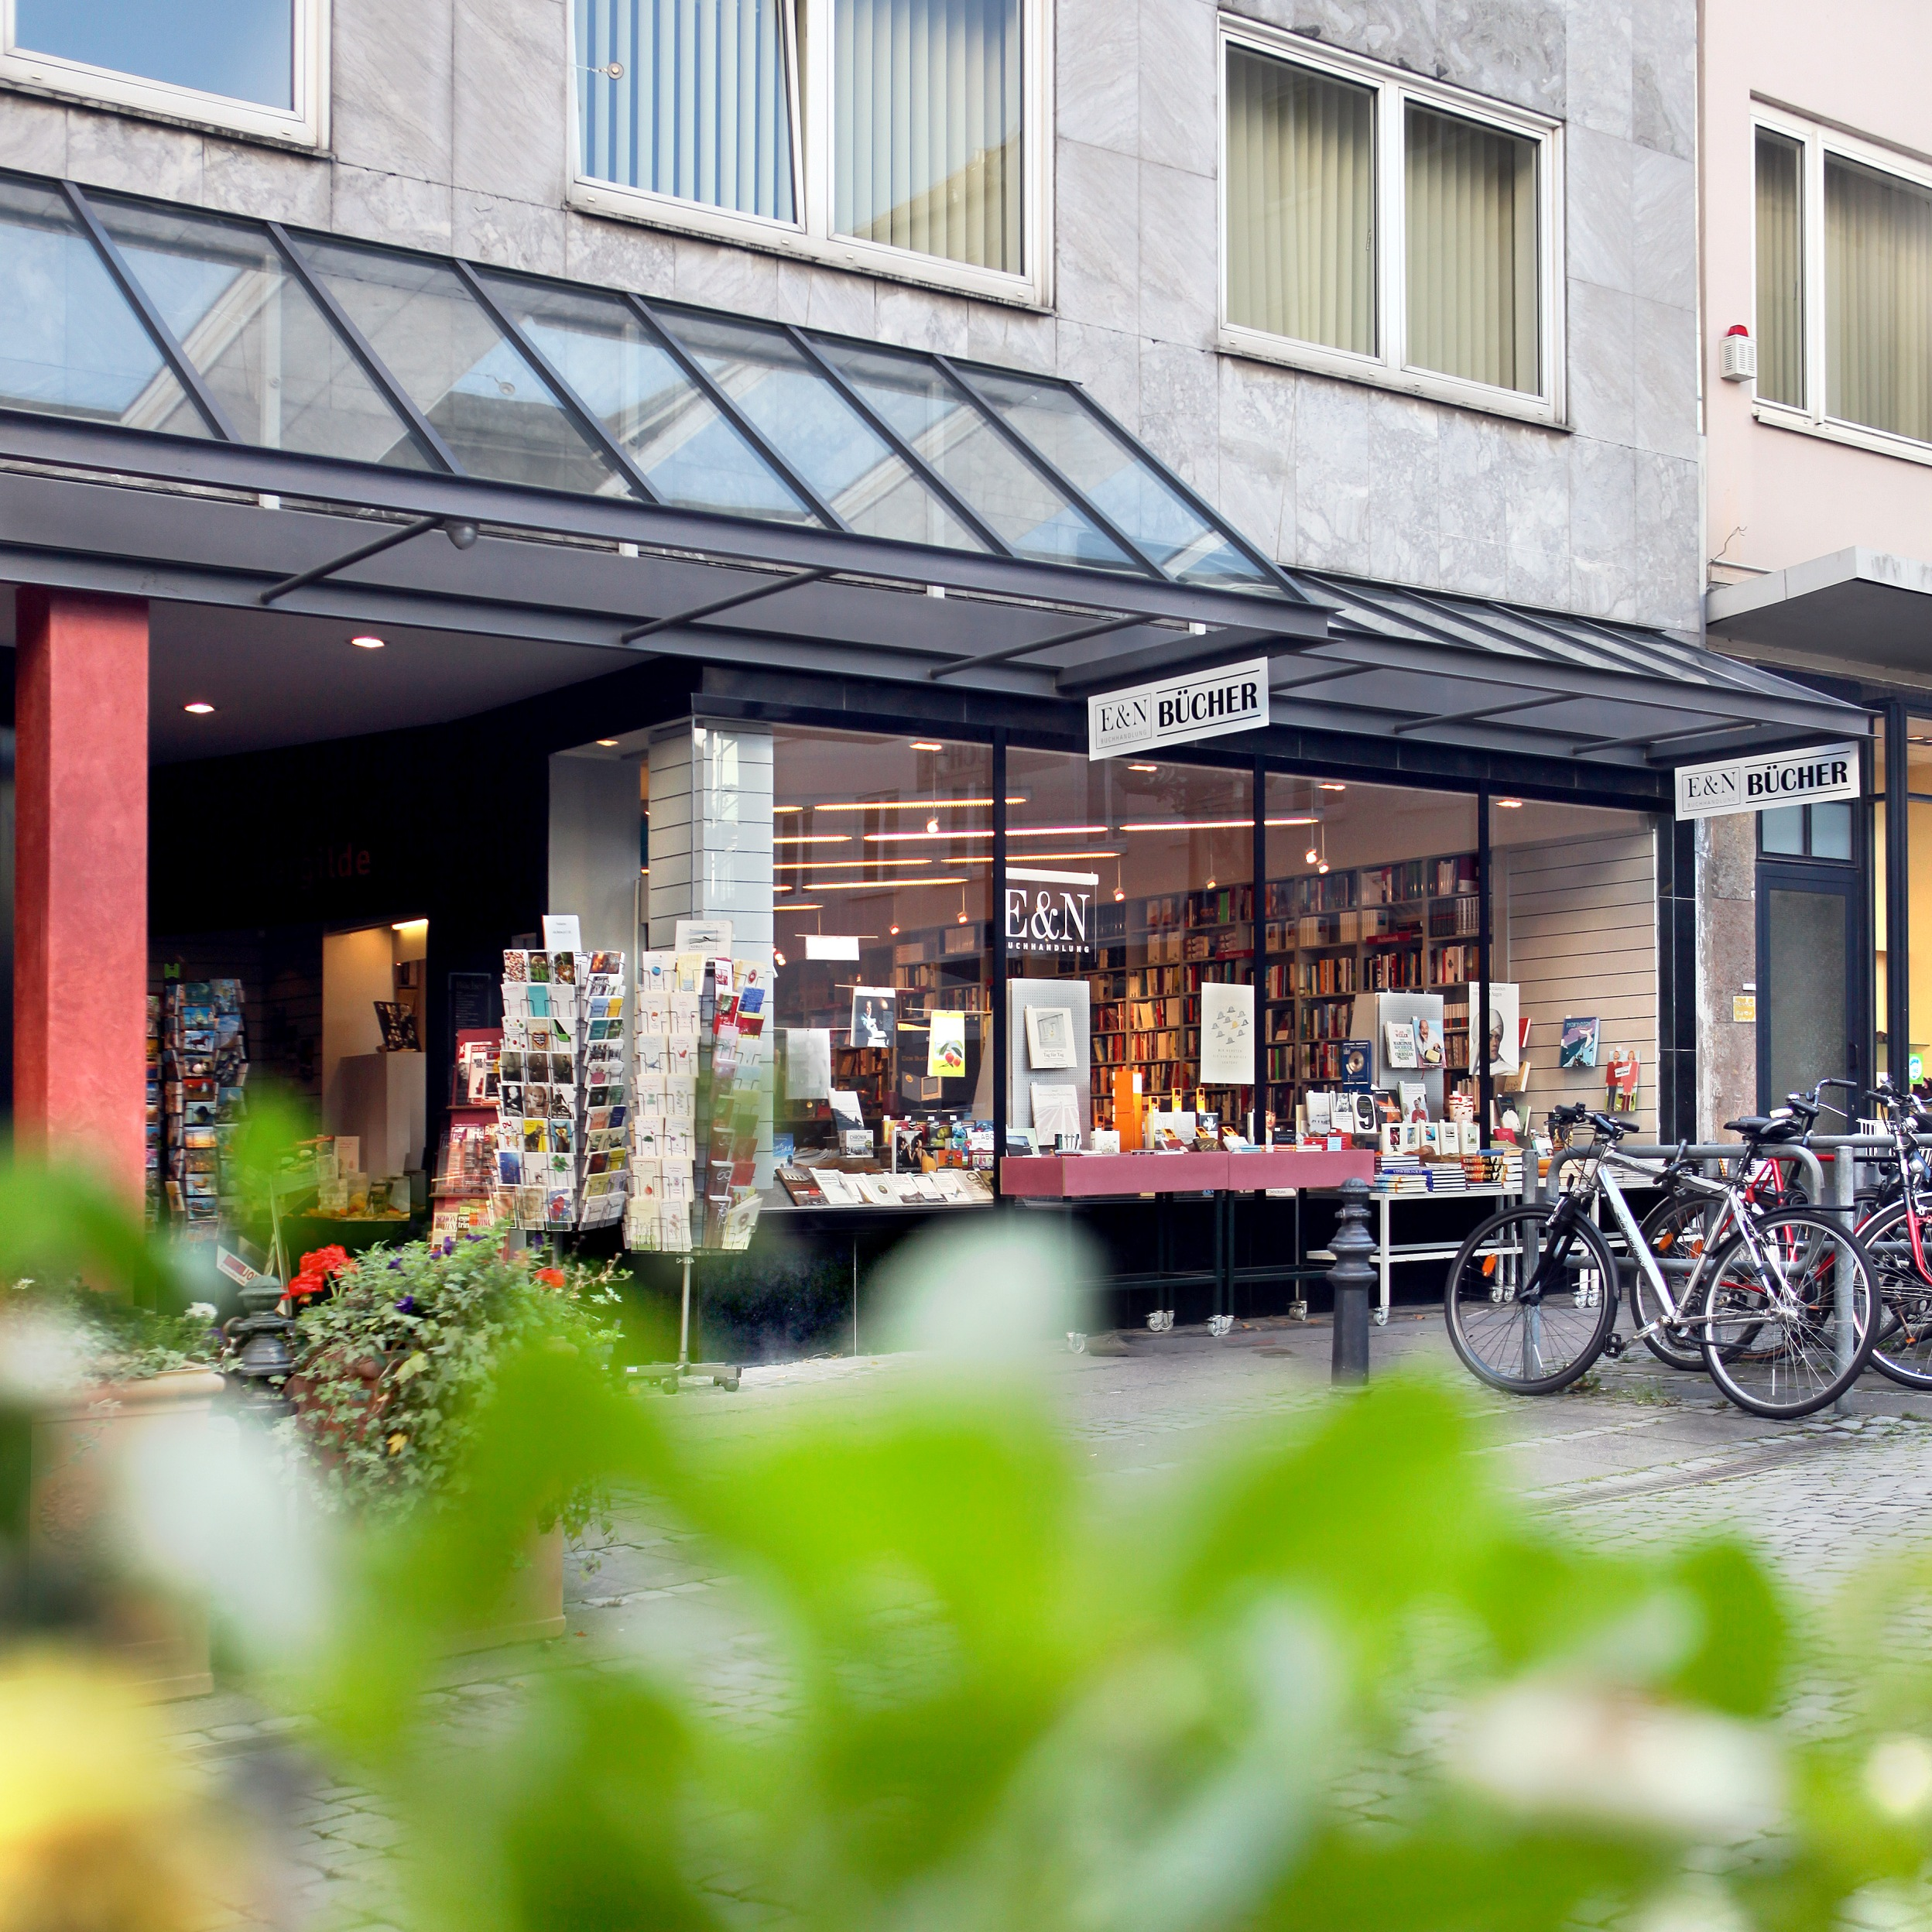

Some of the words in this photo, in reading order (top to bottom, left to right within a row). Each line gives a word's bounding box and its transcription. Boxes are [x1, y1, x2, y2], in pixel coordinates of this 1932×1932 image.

[1101, 698, 1148, 731] E&N
[1158, 682, 1258, 728] BÜCHER
[1100, 729, 1147, 744] BUCHHANDLUNG
[1687, 772, 1735, 797] E&N
[1747, 761, 1848, 796] BÜCHER
[1005, 889, 1091, 942] E&N
[1008, 942, 1089, 953] UCHHANDLUNG
[1357, 1096, 1375, 1130] 9
